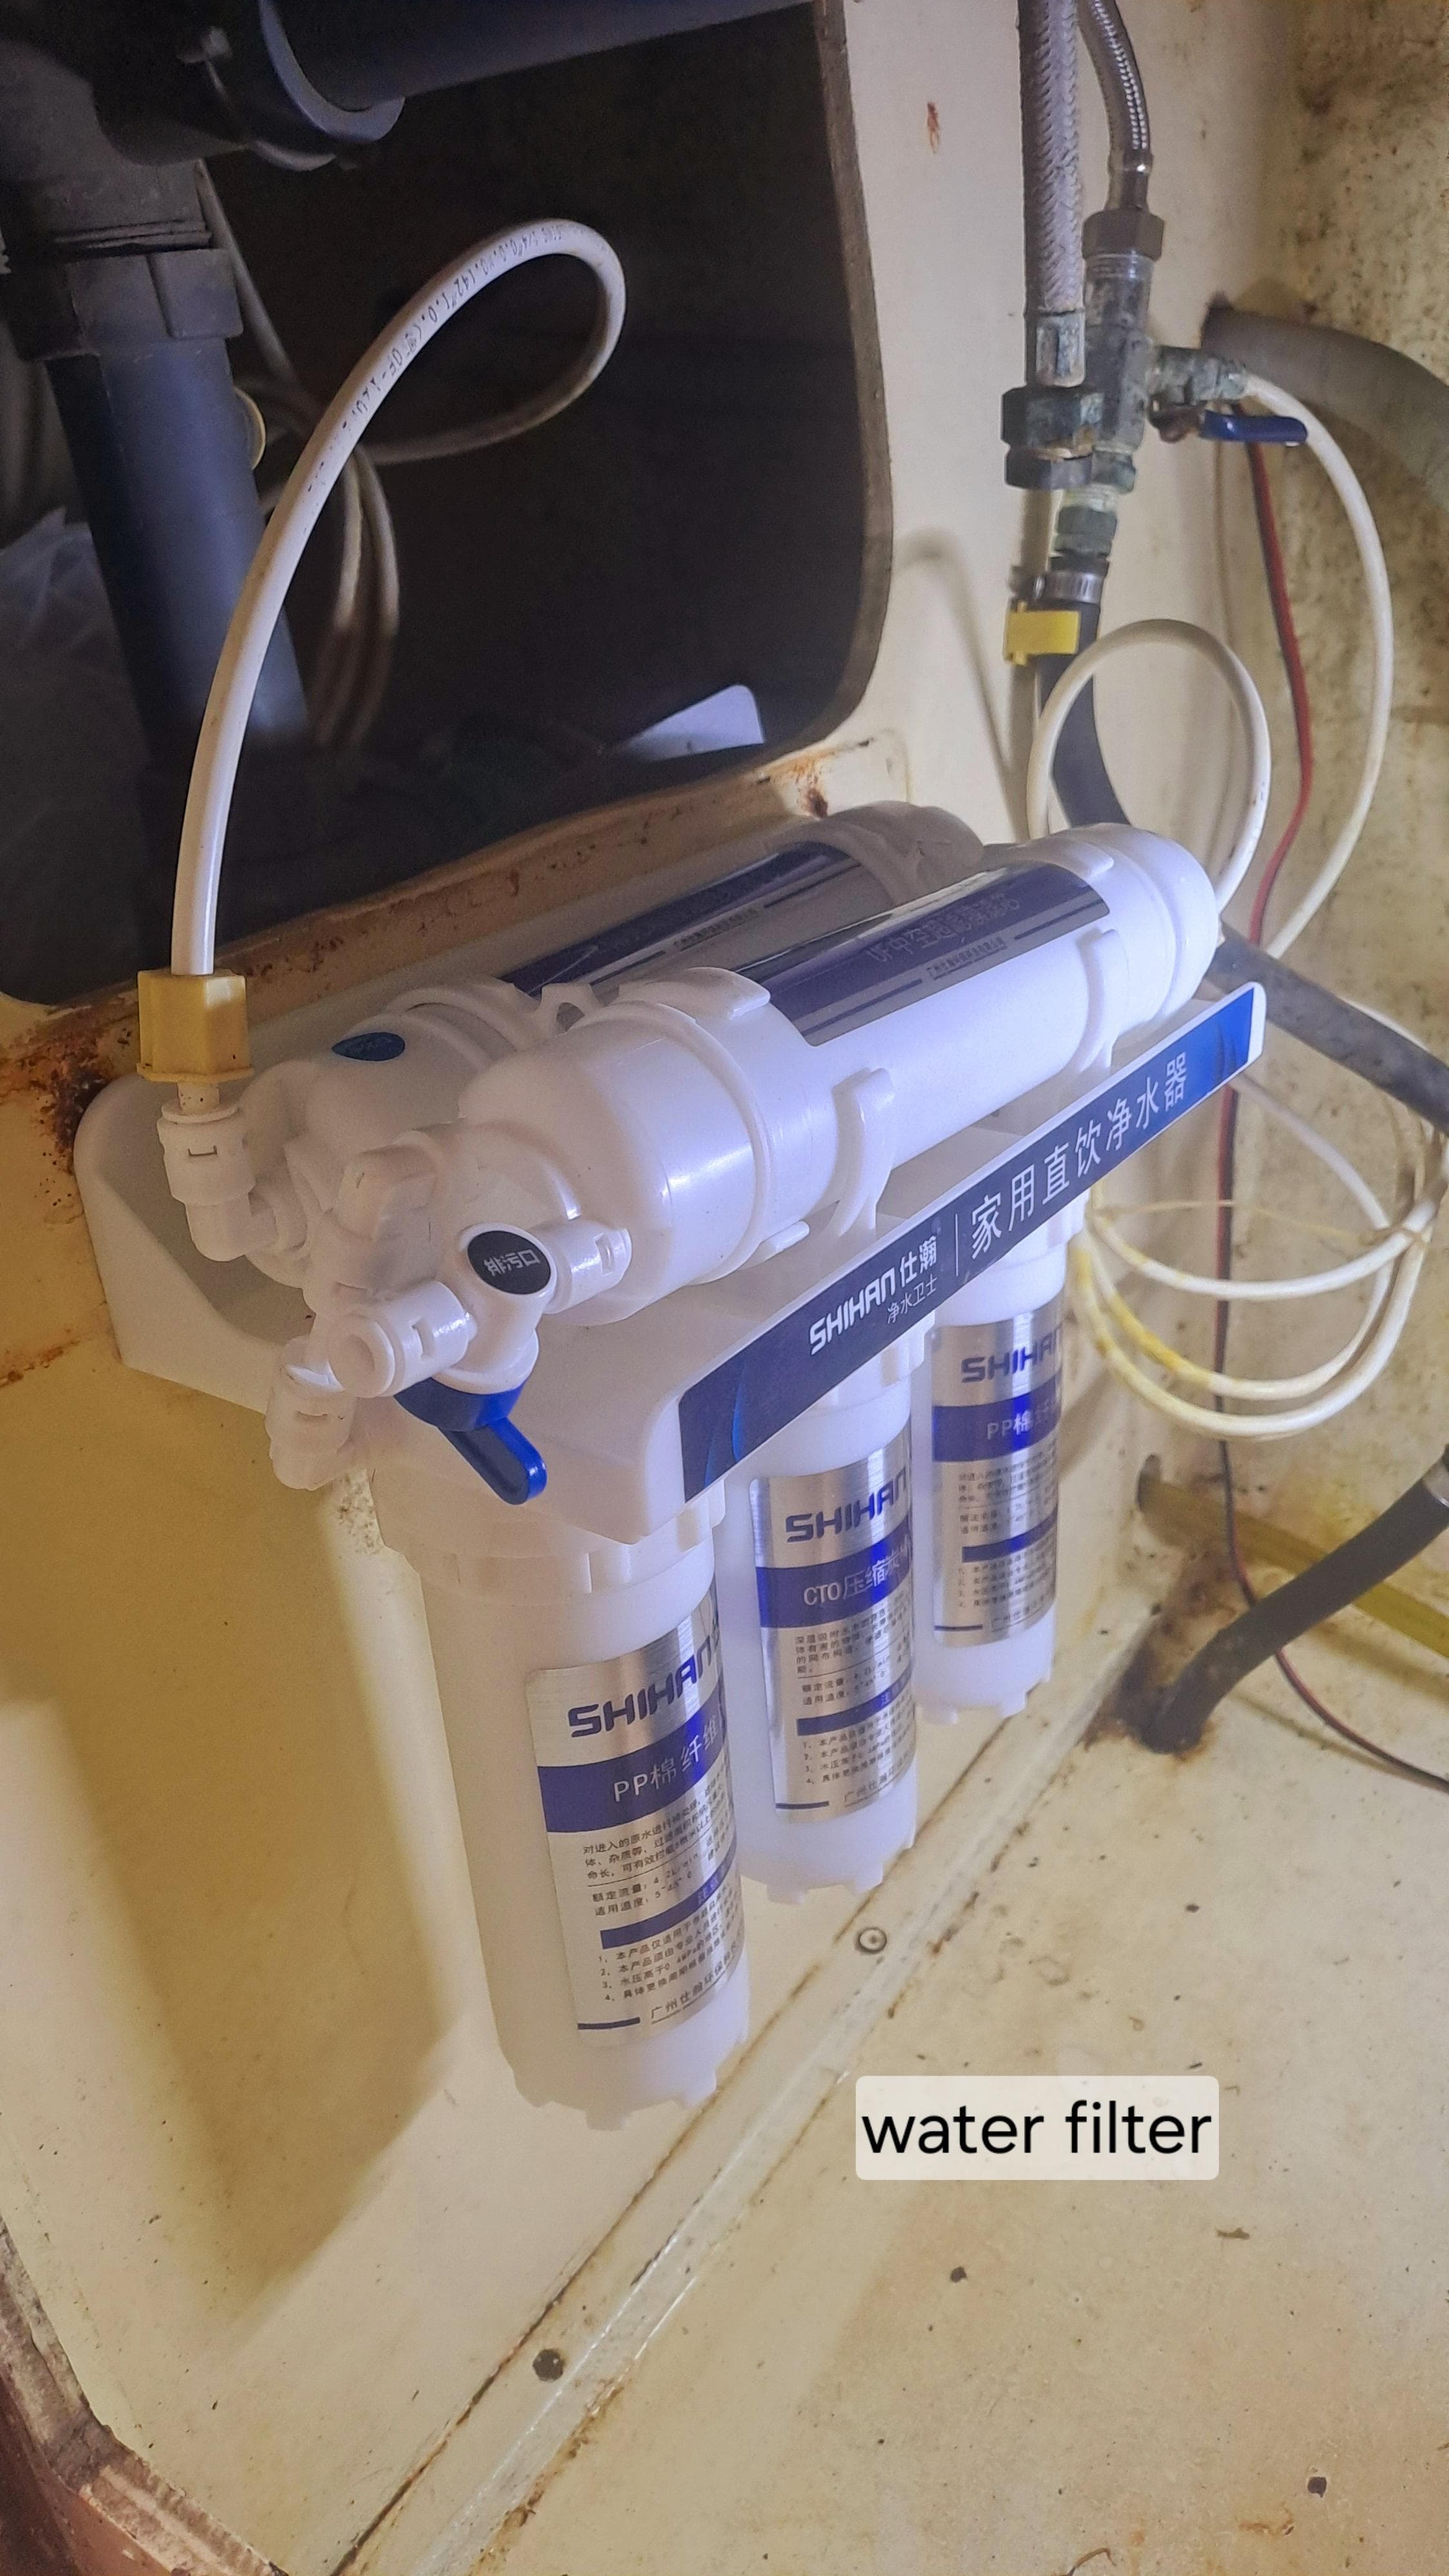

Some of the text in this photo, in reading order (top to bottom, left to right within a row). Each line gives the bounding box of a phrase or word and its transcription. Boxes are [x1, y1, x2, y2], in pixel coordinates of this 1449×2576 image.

[971, 1052, 1187, 1260] 家用直饮净水器
[484, 1249, 540, 1276] 排污口
[809, 1235, 936, 1356] SHIHAN 仕瀚
[887, 1273, 938, 1324] 净水卫士
[785, 1466, 907, 1542] SHIHAN
[567, 1634, 712, 1738] SHIHAN
